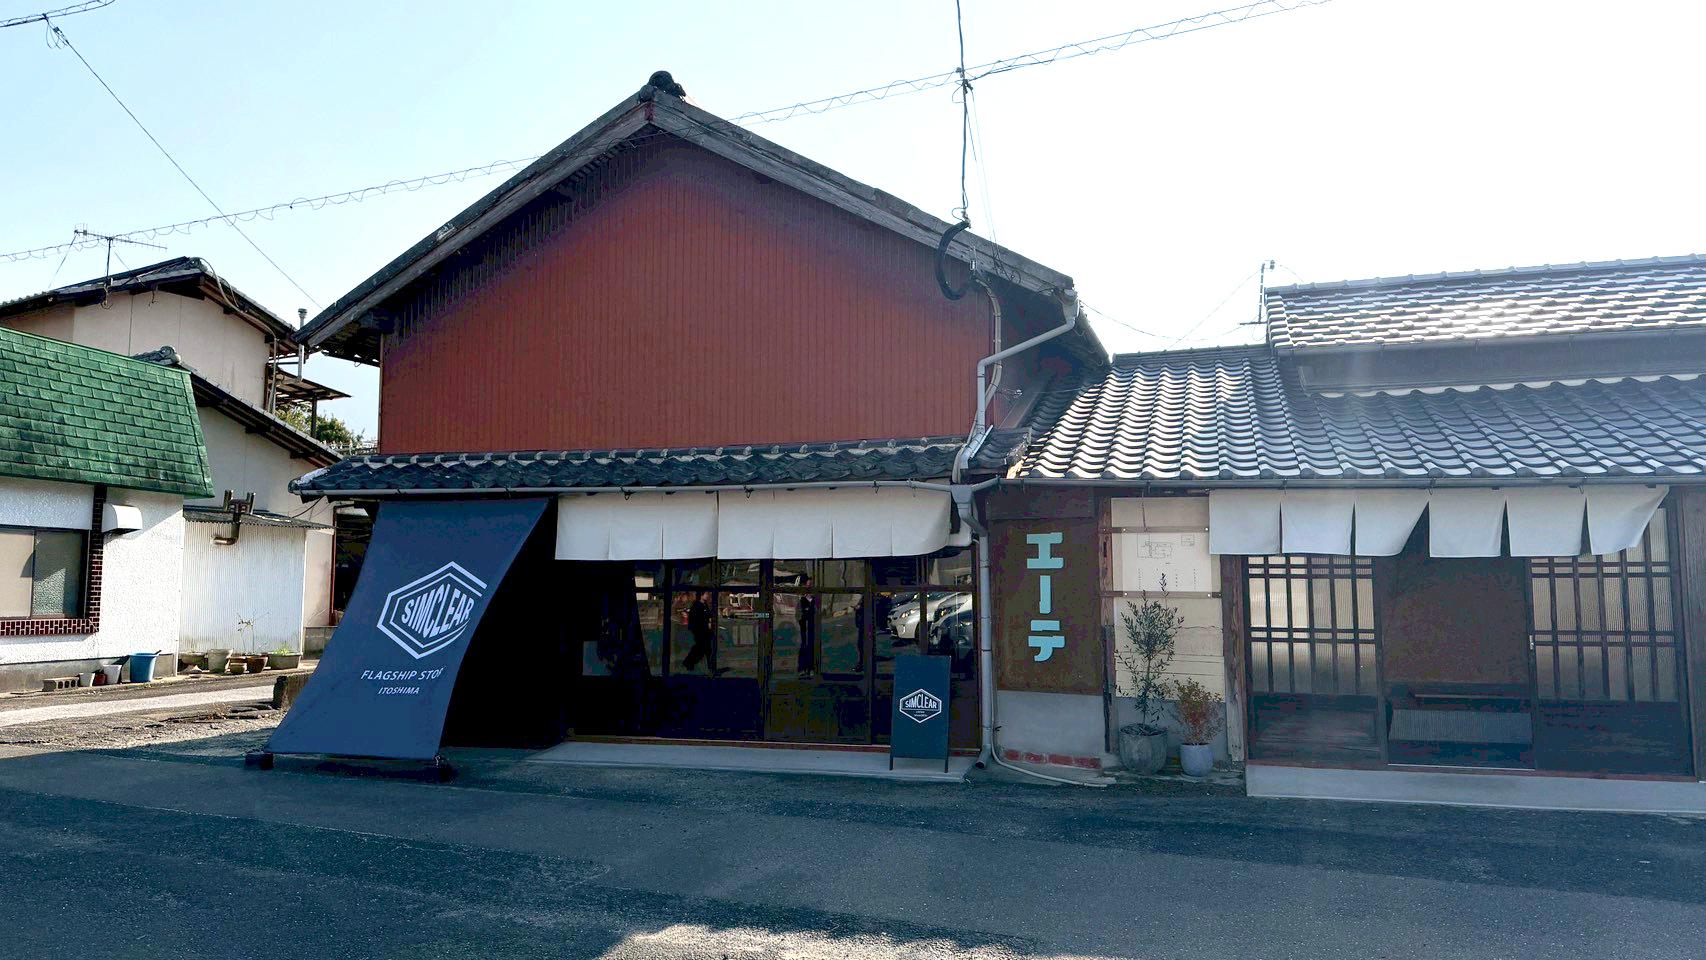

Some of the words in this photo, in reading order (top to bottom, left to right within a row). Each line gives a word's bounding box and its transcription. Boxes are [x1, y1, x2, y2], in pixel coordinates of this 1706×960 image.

[1026, 532, 1065, 662] エーテ
[401, 583, 475, 638] SIMCLEAR
[360, 670, 417, 680] FLAGSHIP
[378, 686, 420, 694] ITOSHIMA
[905, 694, 937, 708] SIMCLEAR
